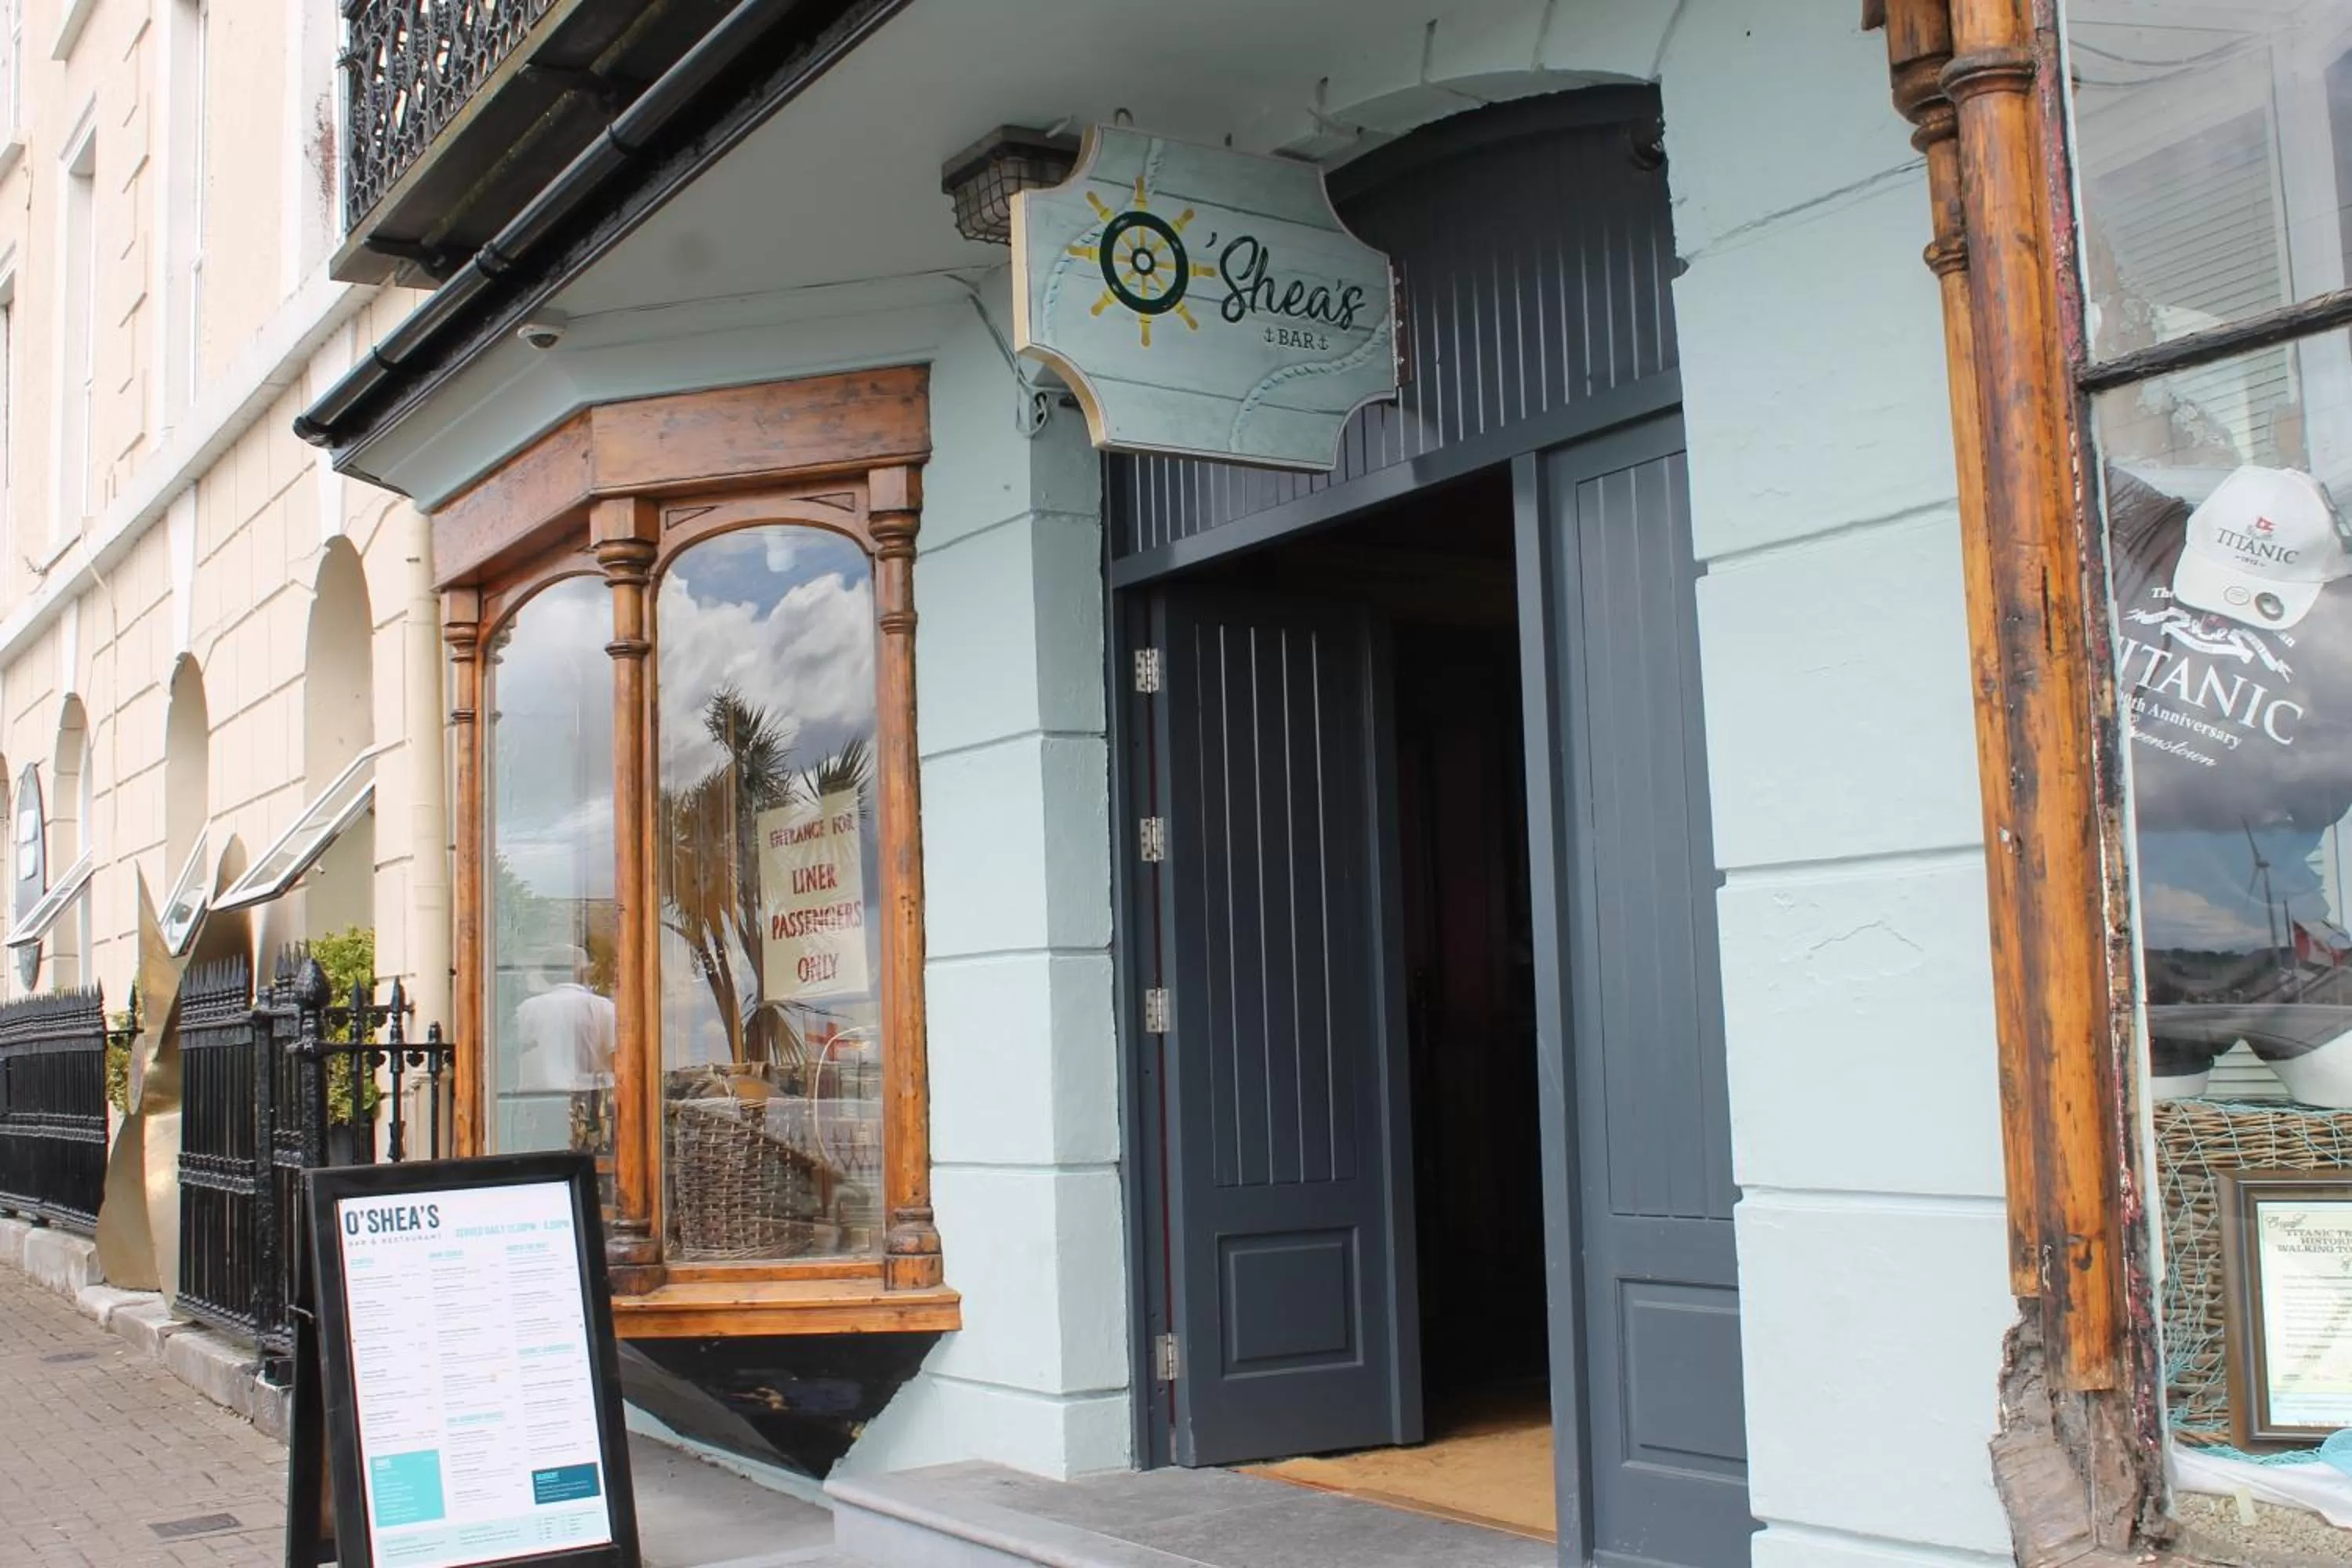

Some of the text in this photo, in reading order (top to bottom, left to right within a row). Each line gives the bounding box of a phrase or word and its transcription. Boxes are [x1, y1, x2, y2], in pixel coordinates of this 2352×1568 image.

[1278, 328, 1315, 350] BAR
[2217, 527, 2299, 564] TITANIC
[2119, 636, 2304, 746] ITANIC
[2147, 703, 2241, 750] Anniversary
[769, 813, 855, 849] ENTRANCE FOR
[792, 864, 837, 895] LINER
[772, 902, 862, 940] PASSENGERS
[797, 953, 839, 982] ONLY
[345, 1204, 440, 1235] O'SHEA'S
[2277, 1244, 2334, 1253] WALKING
